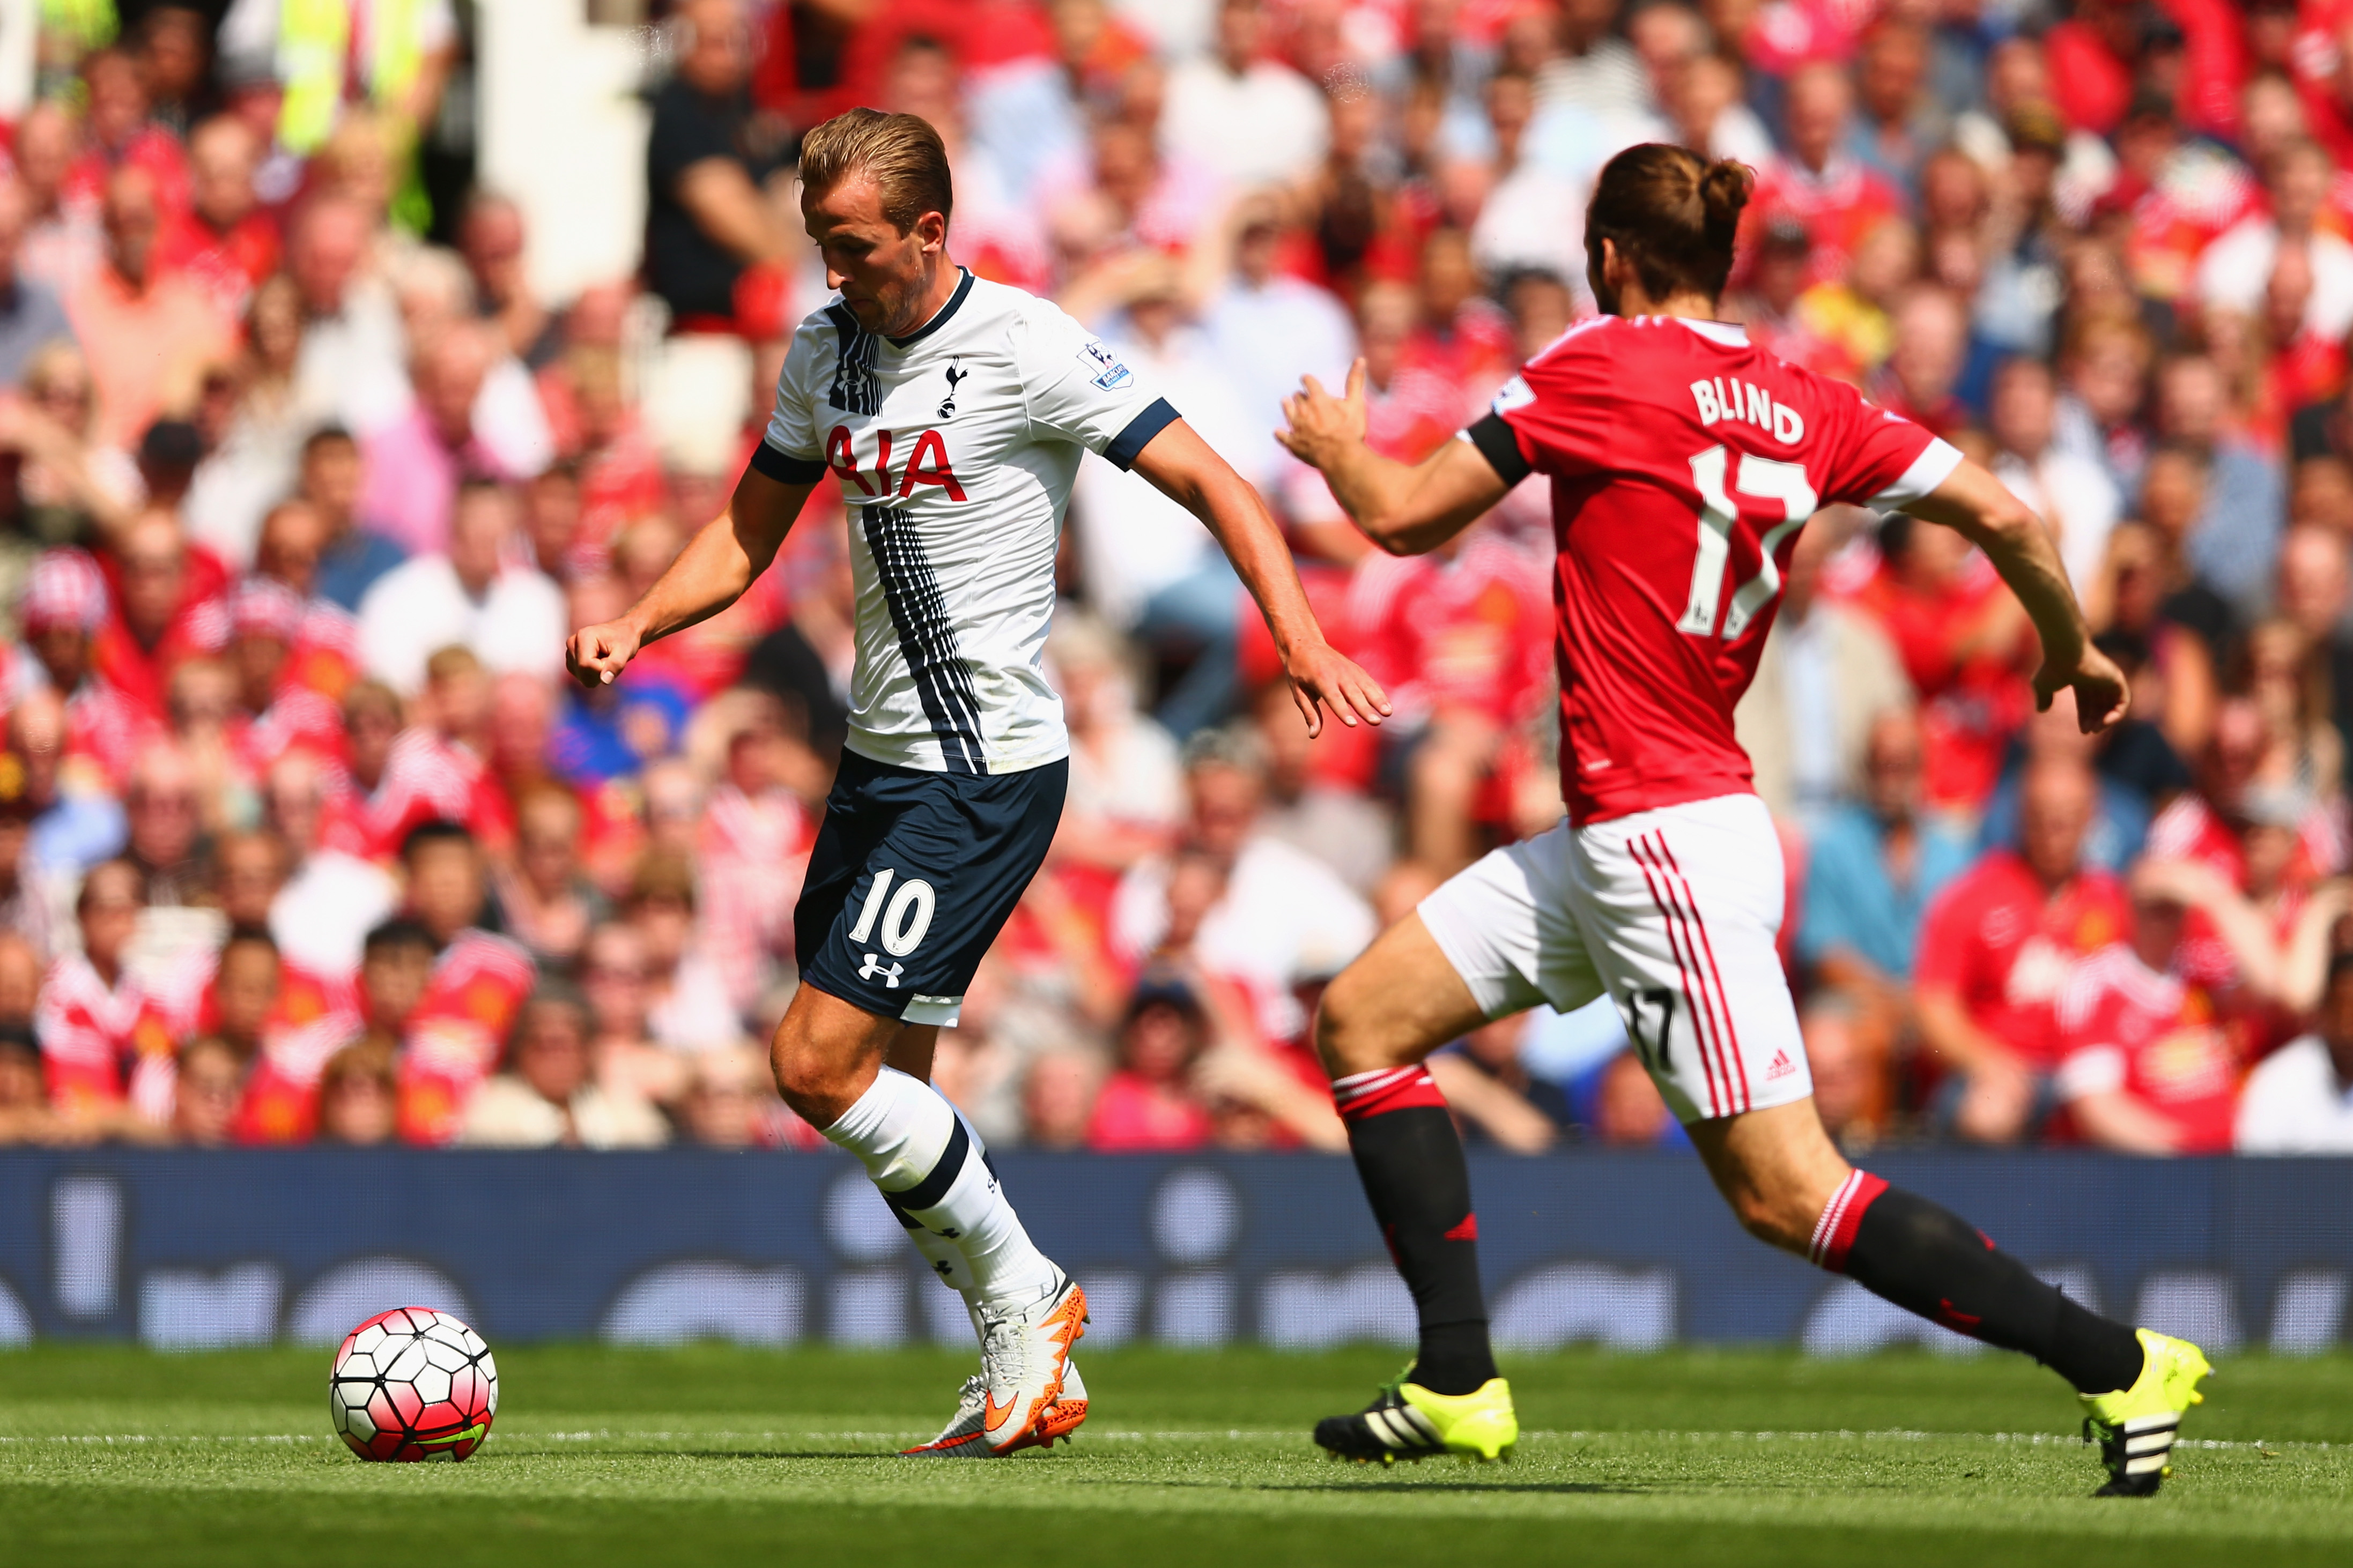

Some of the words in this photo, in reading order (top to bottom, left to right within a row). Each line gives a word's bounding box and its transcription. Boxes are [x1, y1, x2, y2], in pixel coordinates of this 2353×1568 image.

[1690, 376, 1804, 444] BLIND
[826, 425, 968, 502] AIA
[1676, 444, 1818, 640] 17
[849, 868, 935, 957] 10
[1627, 989, 1675, 1072] 17
